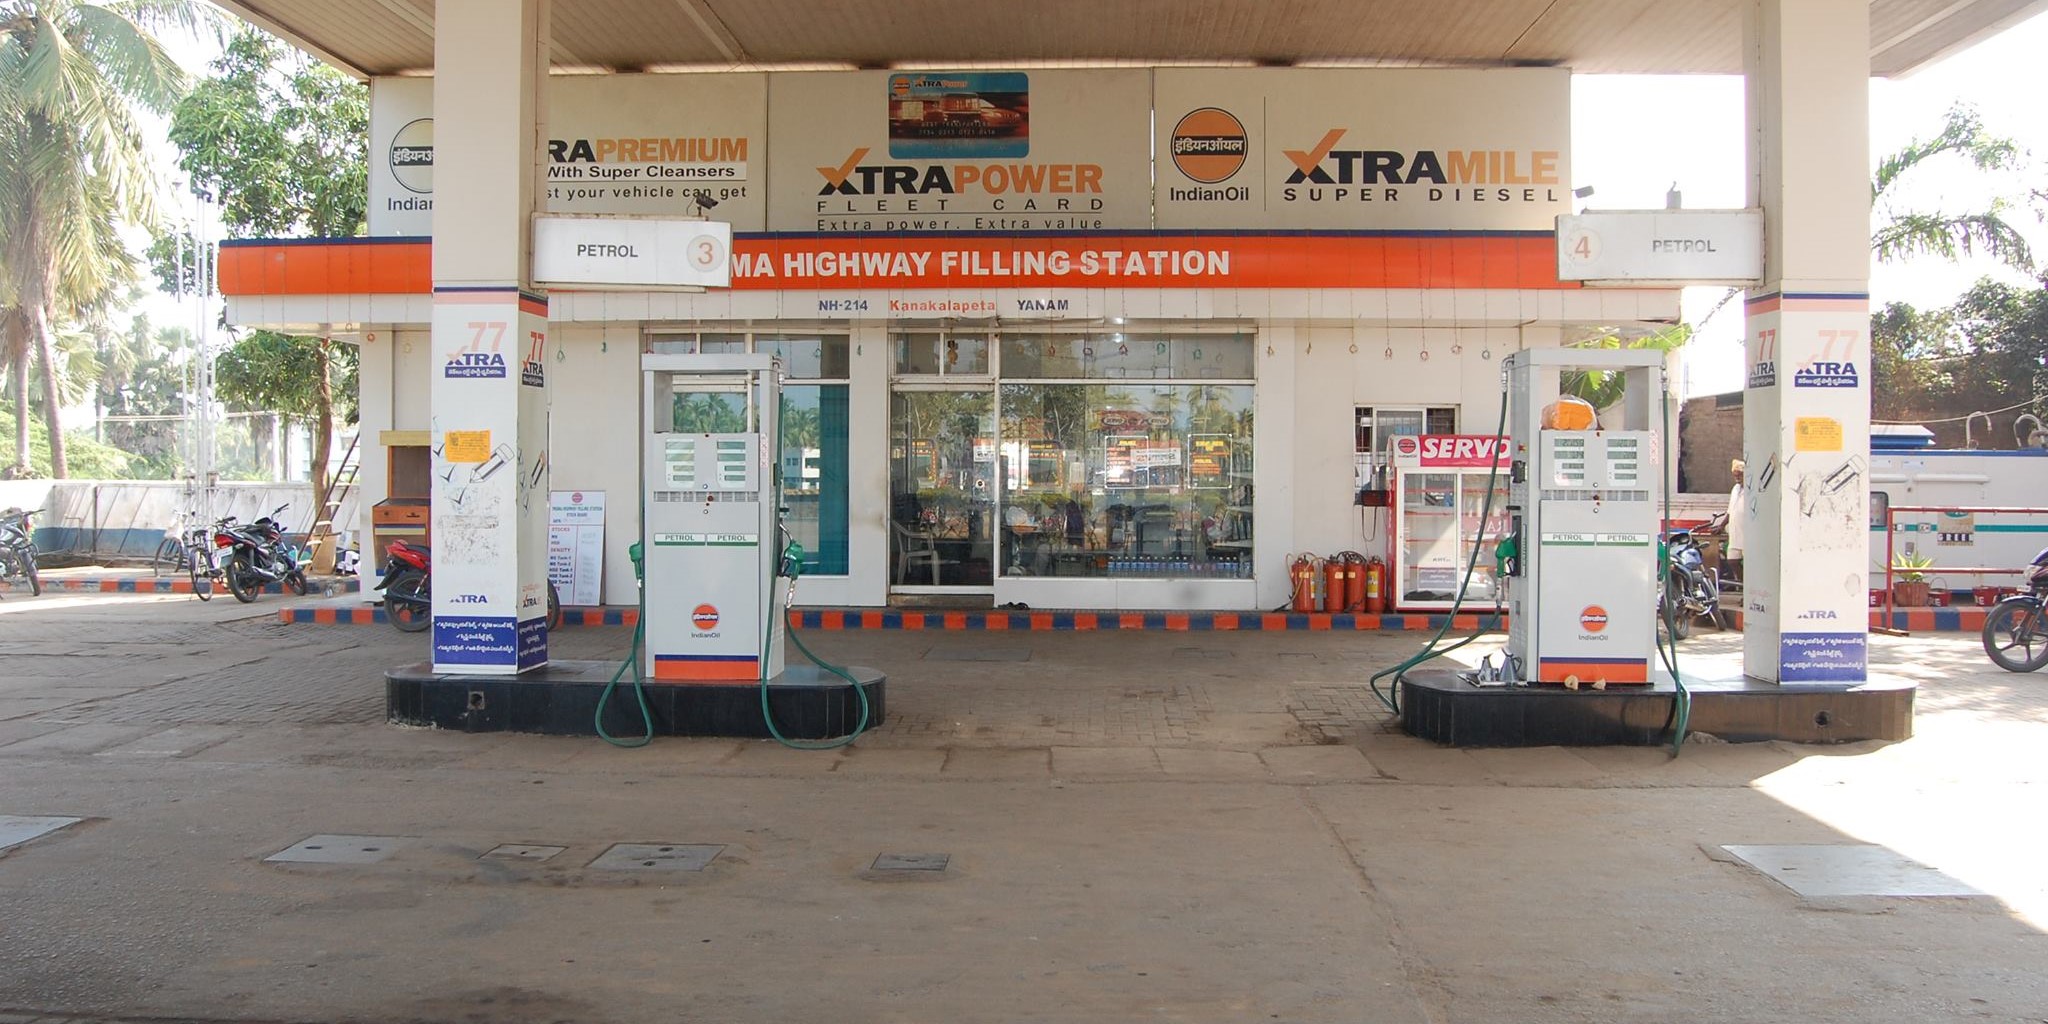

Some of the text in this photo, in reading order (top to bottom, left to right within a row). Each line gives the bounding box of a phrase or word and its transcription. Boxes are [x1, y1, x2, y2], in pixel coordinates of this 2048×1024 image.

[1174, 138, 1243, 153] इंडियनऑयल
[1282, 128, 1559, 184] XTRAMILE
[589, 165, 641, 180] Super
[646, 165, 735, 177] Cleansers
[816, 148, 1103, 195] XTRAPOWER
[566, 188, 606, 201] your
[613, 185, 674, 198] vehicle
[682, 186, 712, 198] can
[720, 186, 748, 200] get
[1170, 186, 1249, 201] IndianOil
[1284, 188, 1559, 202] SUPER DIESEL
[817, 199, 1103, 212] FLEET CARD
[817, 218, 1102, 232] Extra power. Extra value
[576, 242, 714, 265] PETROL 3
[1574, 235, 1716, 259] 4 PETROL
[730, 250, 1230, 277] MA HIGHWAY FILLING STATION
[818, 299, 1069, 313] NH-214 Kanakalapeta YANAM
[1421, 437, 1512, 459] SERVO
